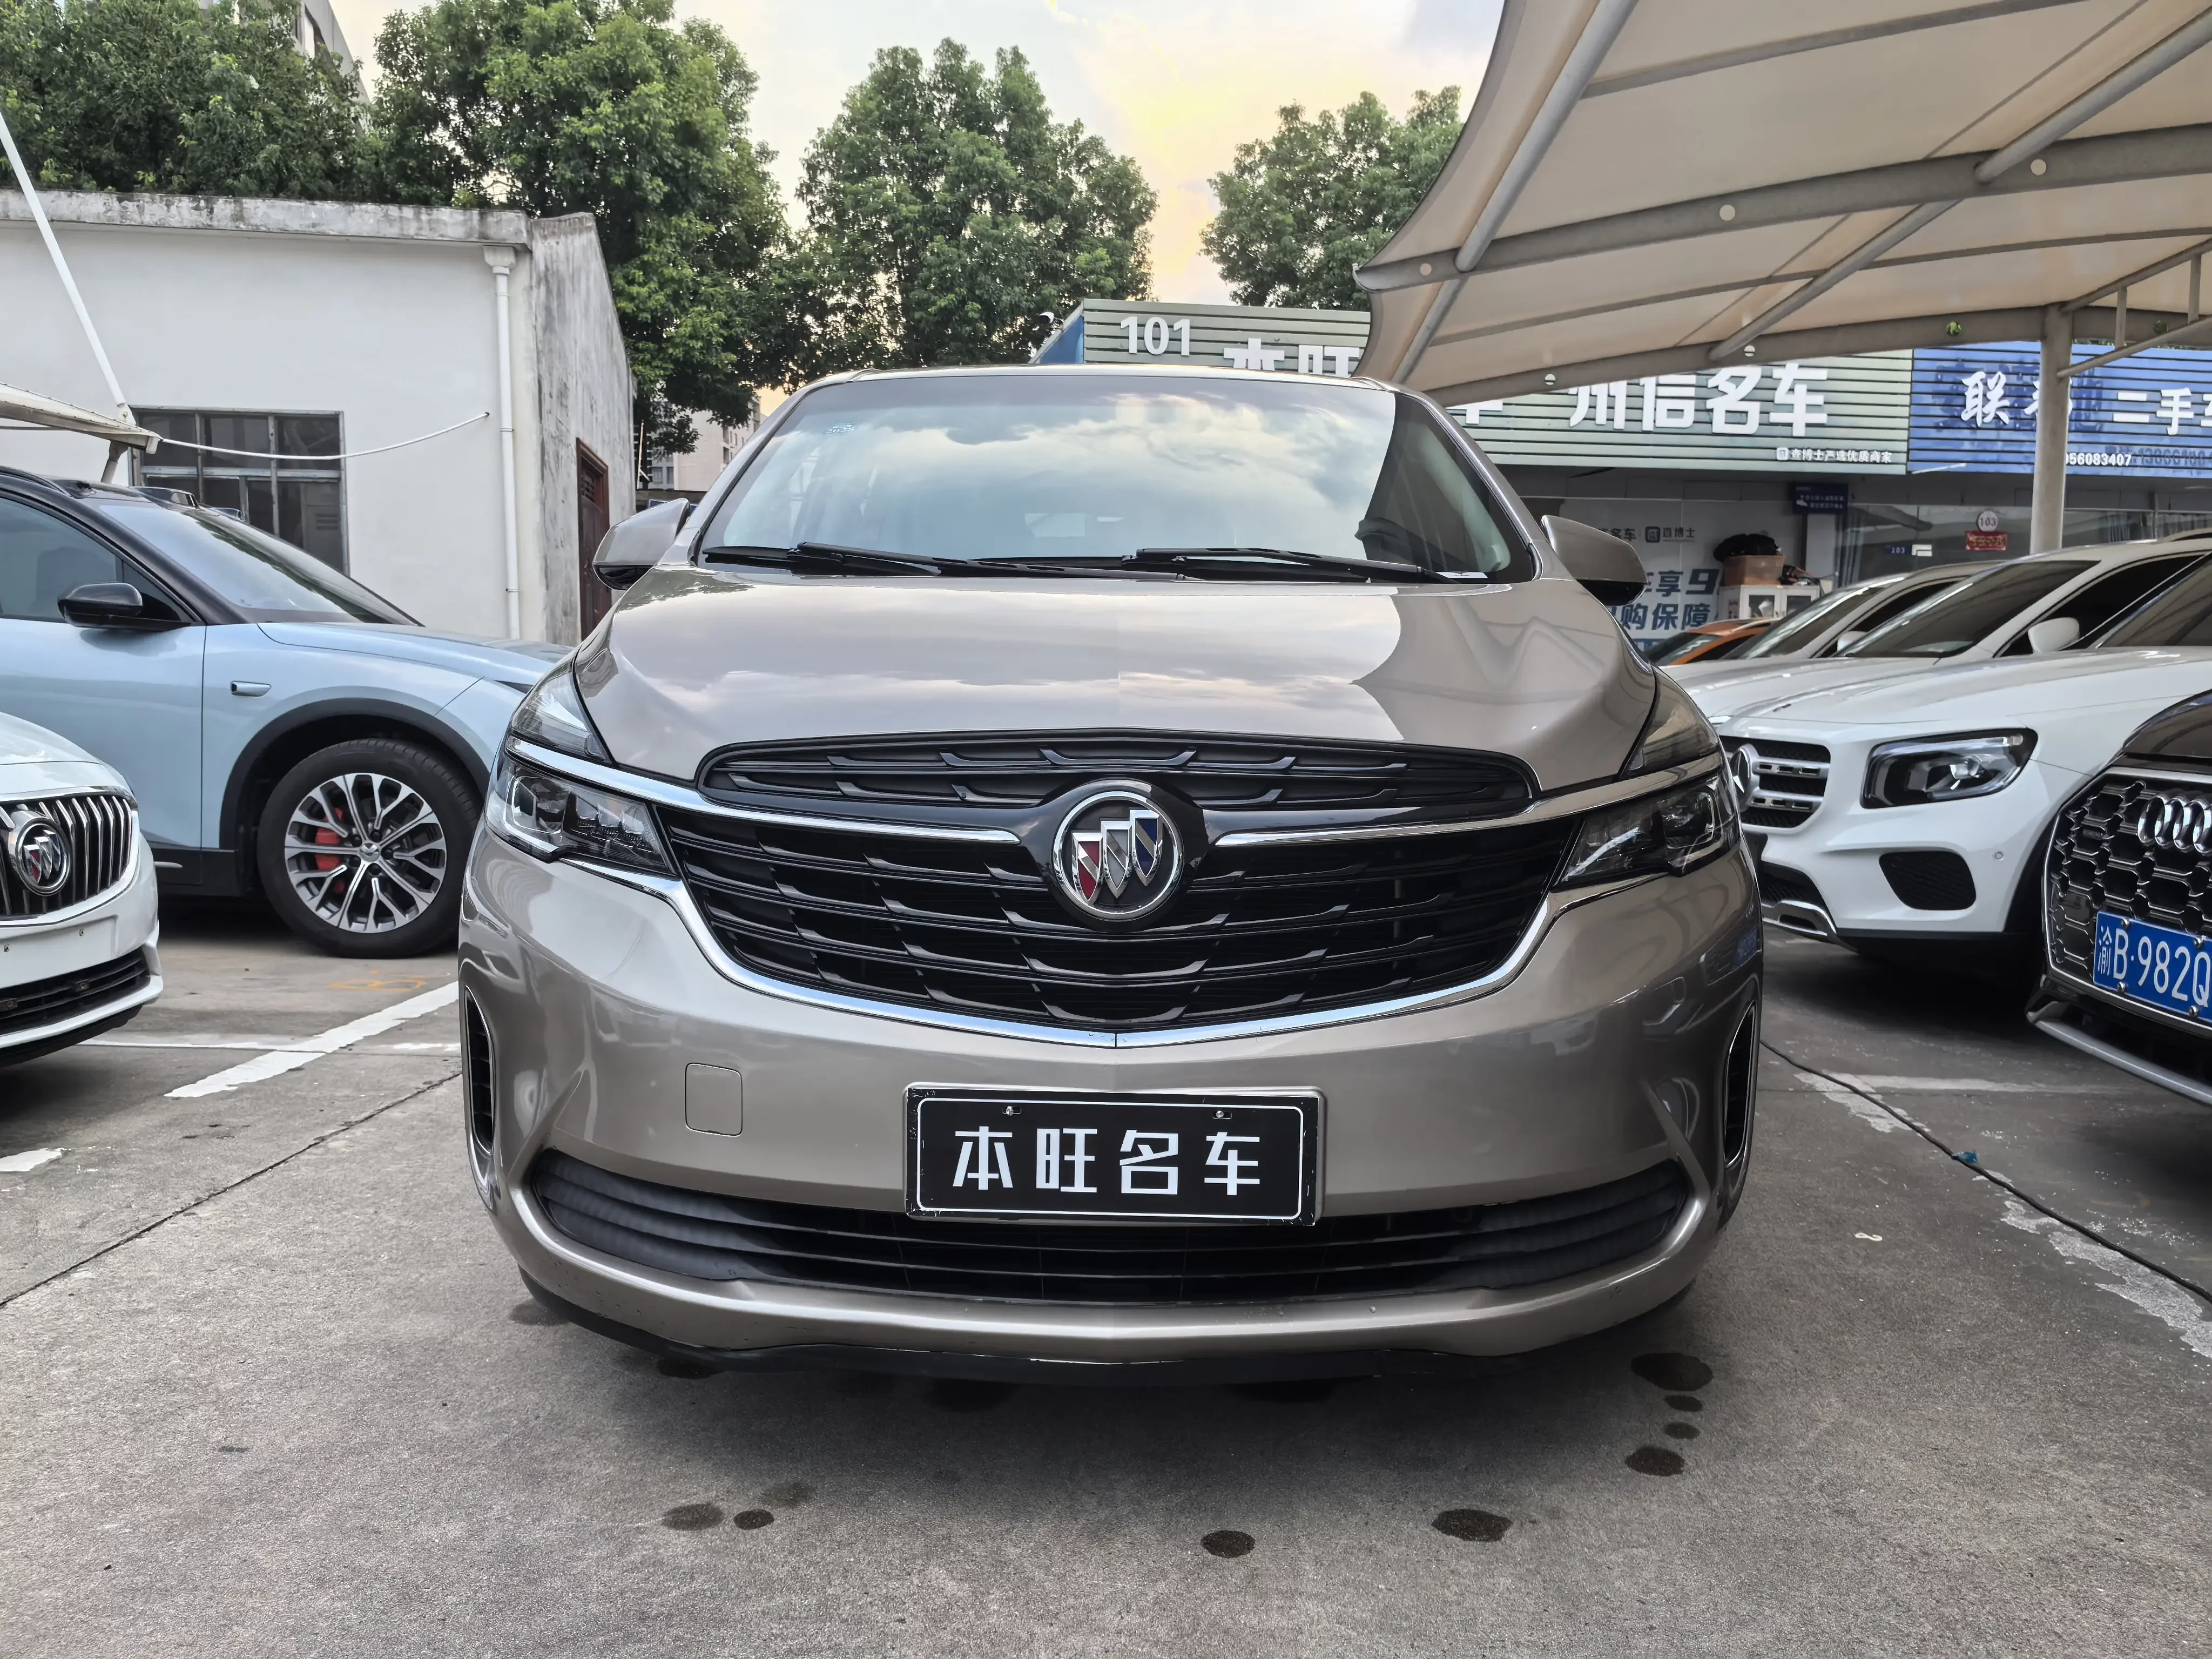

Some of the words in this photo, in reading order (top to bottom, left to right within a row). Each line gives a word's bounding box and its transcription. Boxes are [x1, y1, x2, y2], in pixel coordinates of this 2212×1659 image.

[1121, 316, 1190, 356] 101
[2113, 387, 2212, 435] 二手
[1979, 516, 1997, 527] 103
[953, 1125, 1260, 1196] 本旺名车
